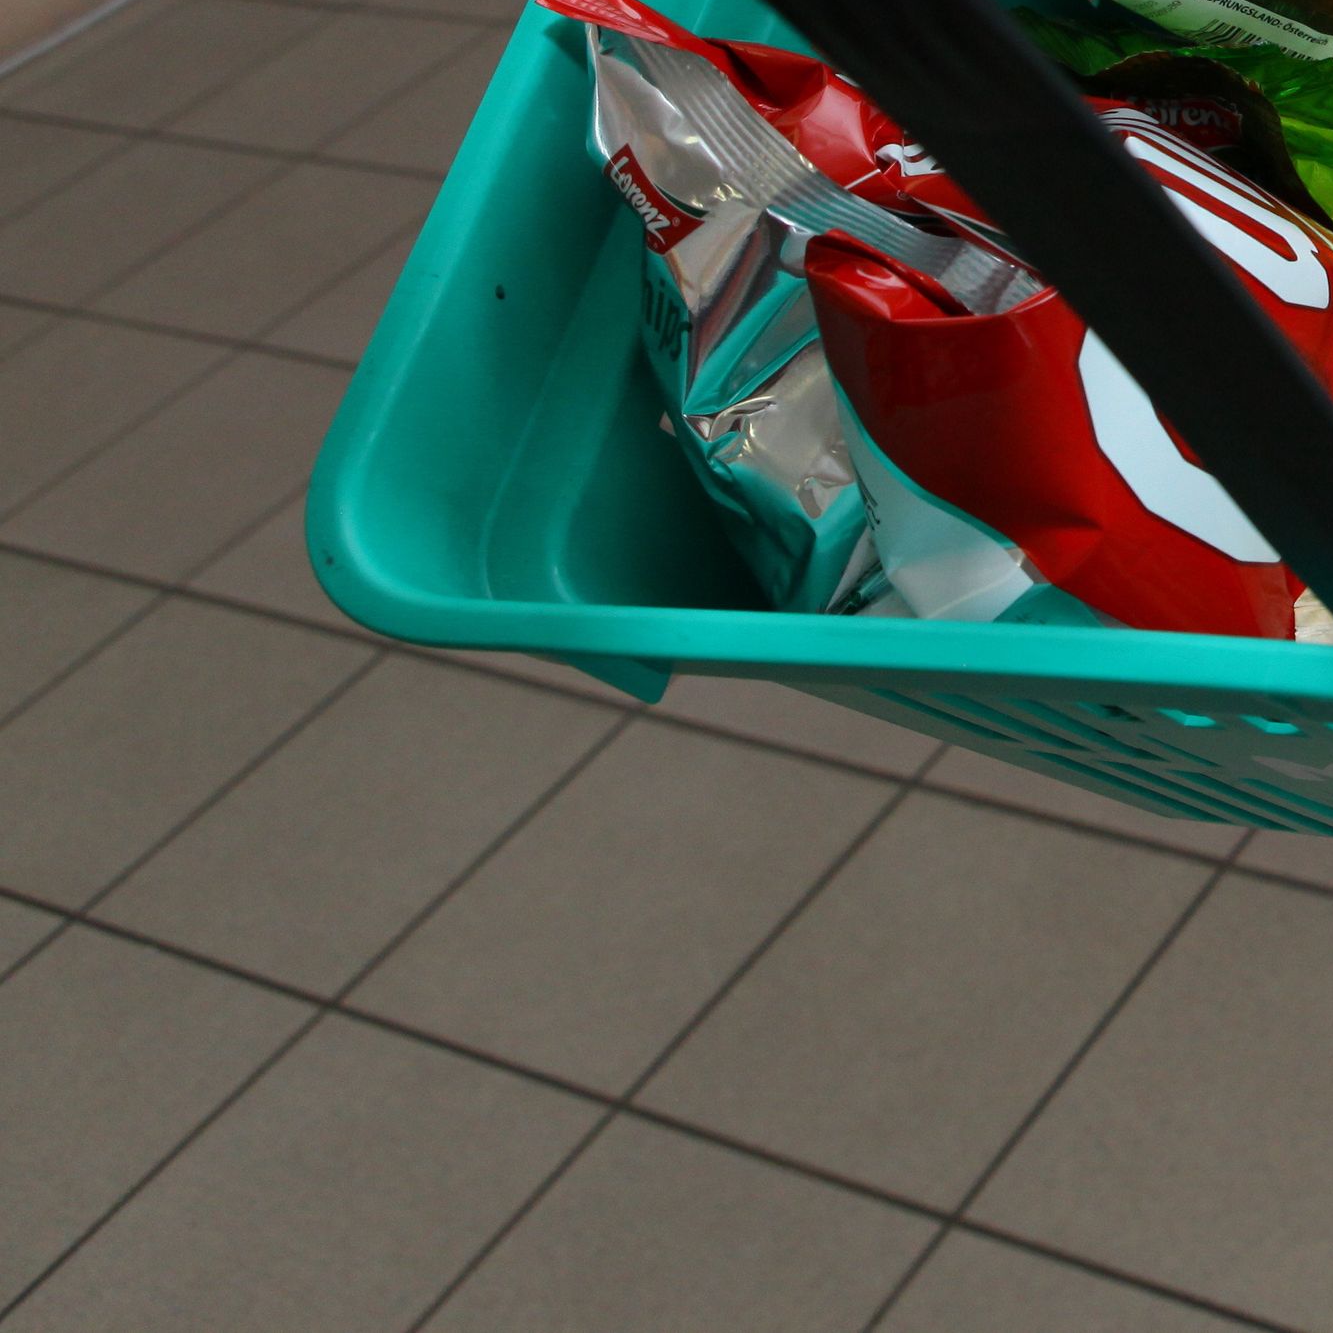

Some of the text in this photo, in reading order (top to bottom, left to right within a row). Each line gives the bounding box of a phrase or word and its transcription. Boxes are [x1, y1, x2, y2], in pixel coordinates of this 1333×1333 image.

[1282, 21, 1329, 47] Österreich
[610, 156, 672, 246] Lorenz
[641, 274, 692, 362] hips
